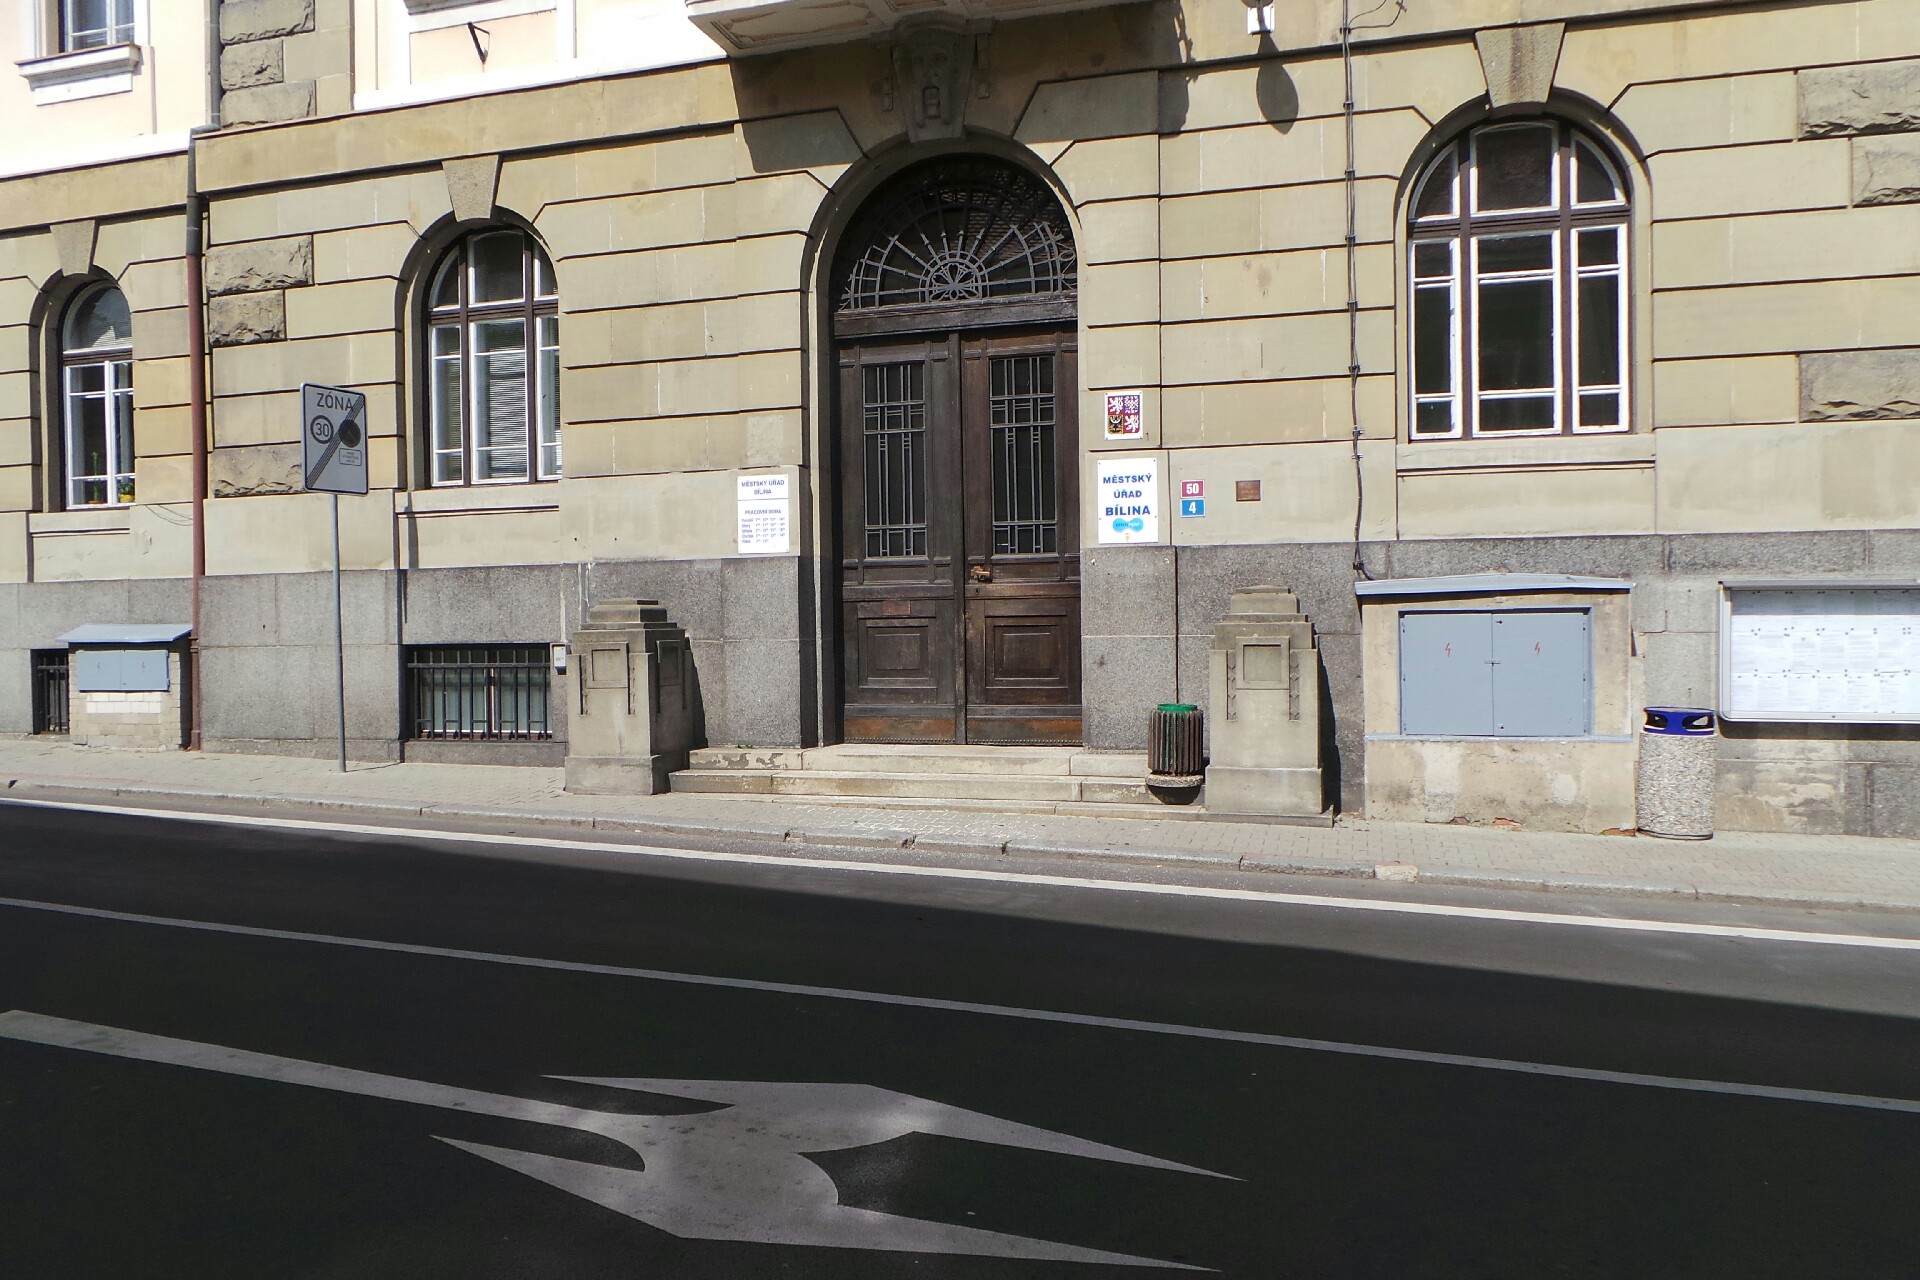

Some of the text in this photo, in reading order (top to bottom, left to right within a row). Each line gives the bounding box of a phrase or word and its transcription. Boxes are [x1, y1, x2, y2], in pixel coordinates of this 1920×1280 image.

[316, 391, 354, 412] ZÓNA
[315, 423, 330, 437] 30
[1103, 472, 1152, 484] MĚSTSKÝ
[1113, 489, 1142, 499] ÚŘAD
[1186, 482, 1200, 495] 50
[1105, 504, 1151, 516] BÍLINA
[1188, 501, 1197, 514] 4
